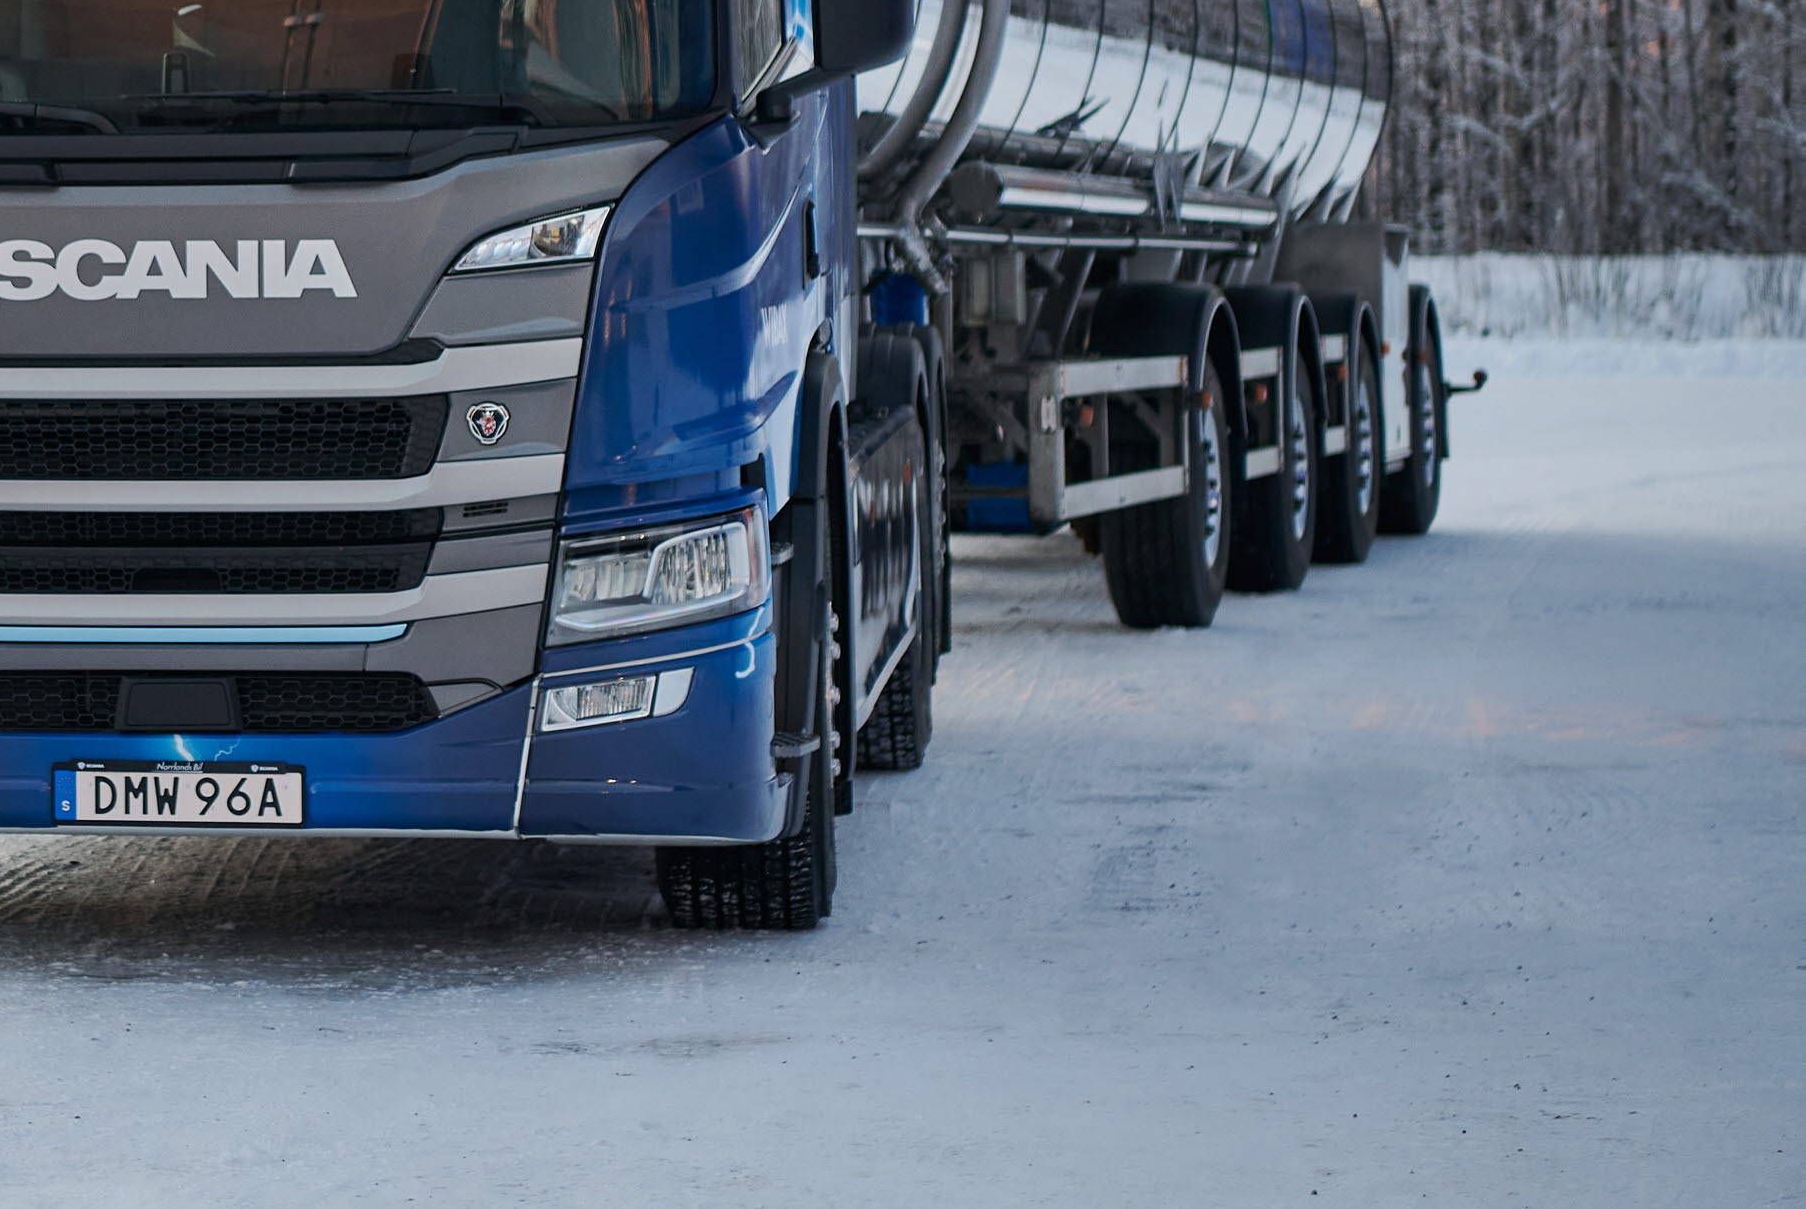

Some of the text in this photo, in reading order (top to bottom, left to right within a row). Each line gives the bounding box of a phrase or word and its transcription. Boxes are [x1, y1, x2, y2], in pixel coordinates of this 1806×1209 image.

[156, 762, 192, 771] Norrlands
[95, 776, 283, 817] DMW 96A
[61, 800, 71, 812] S
